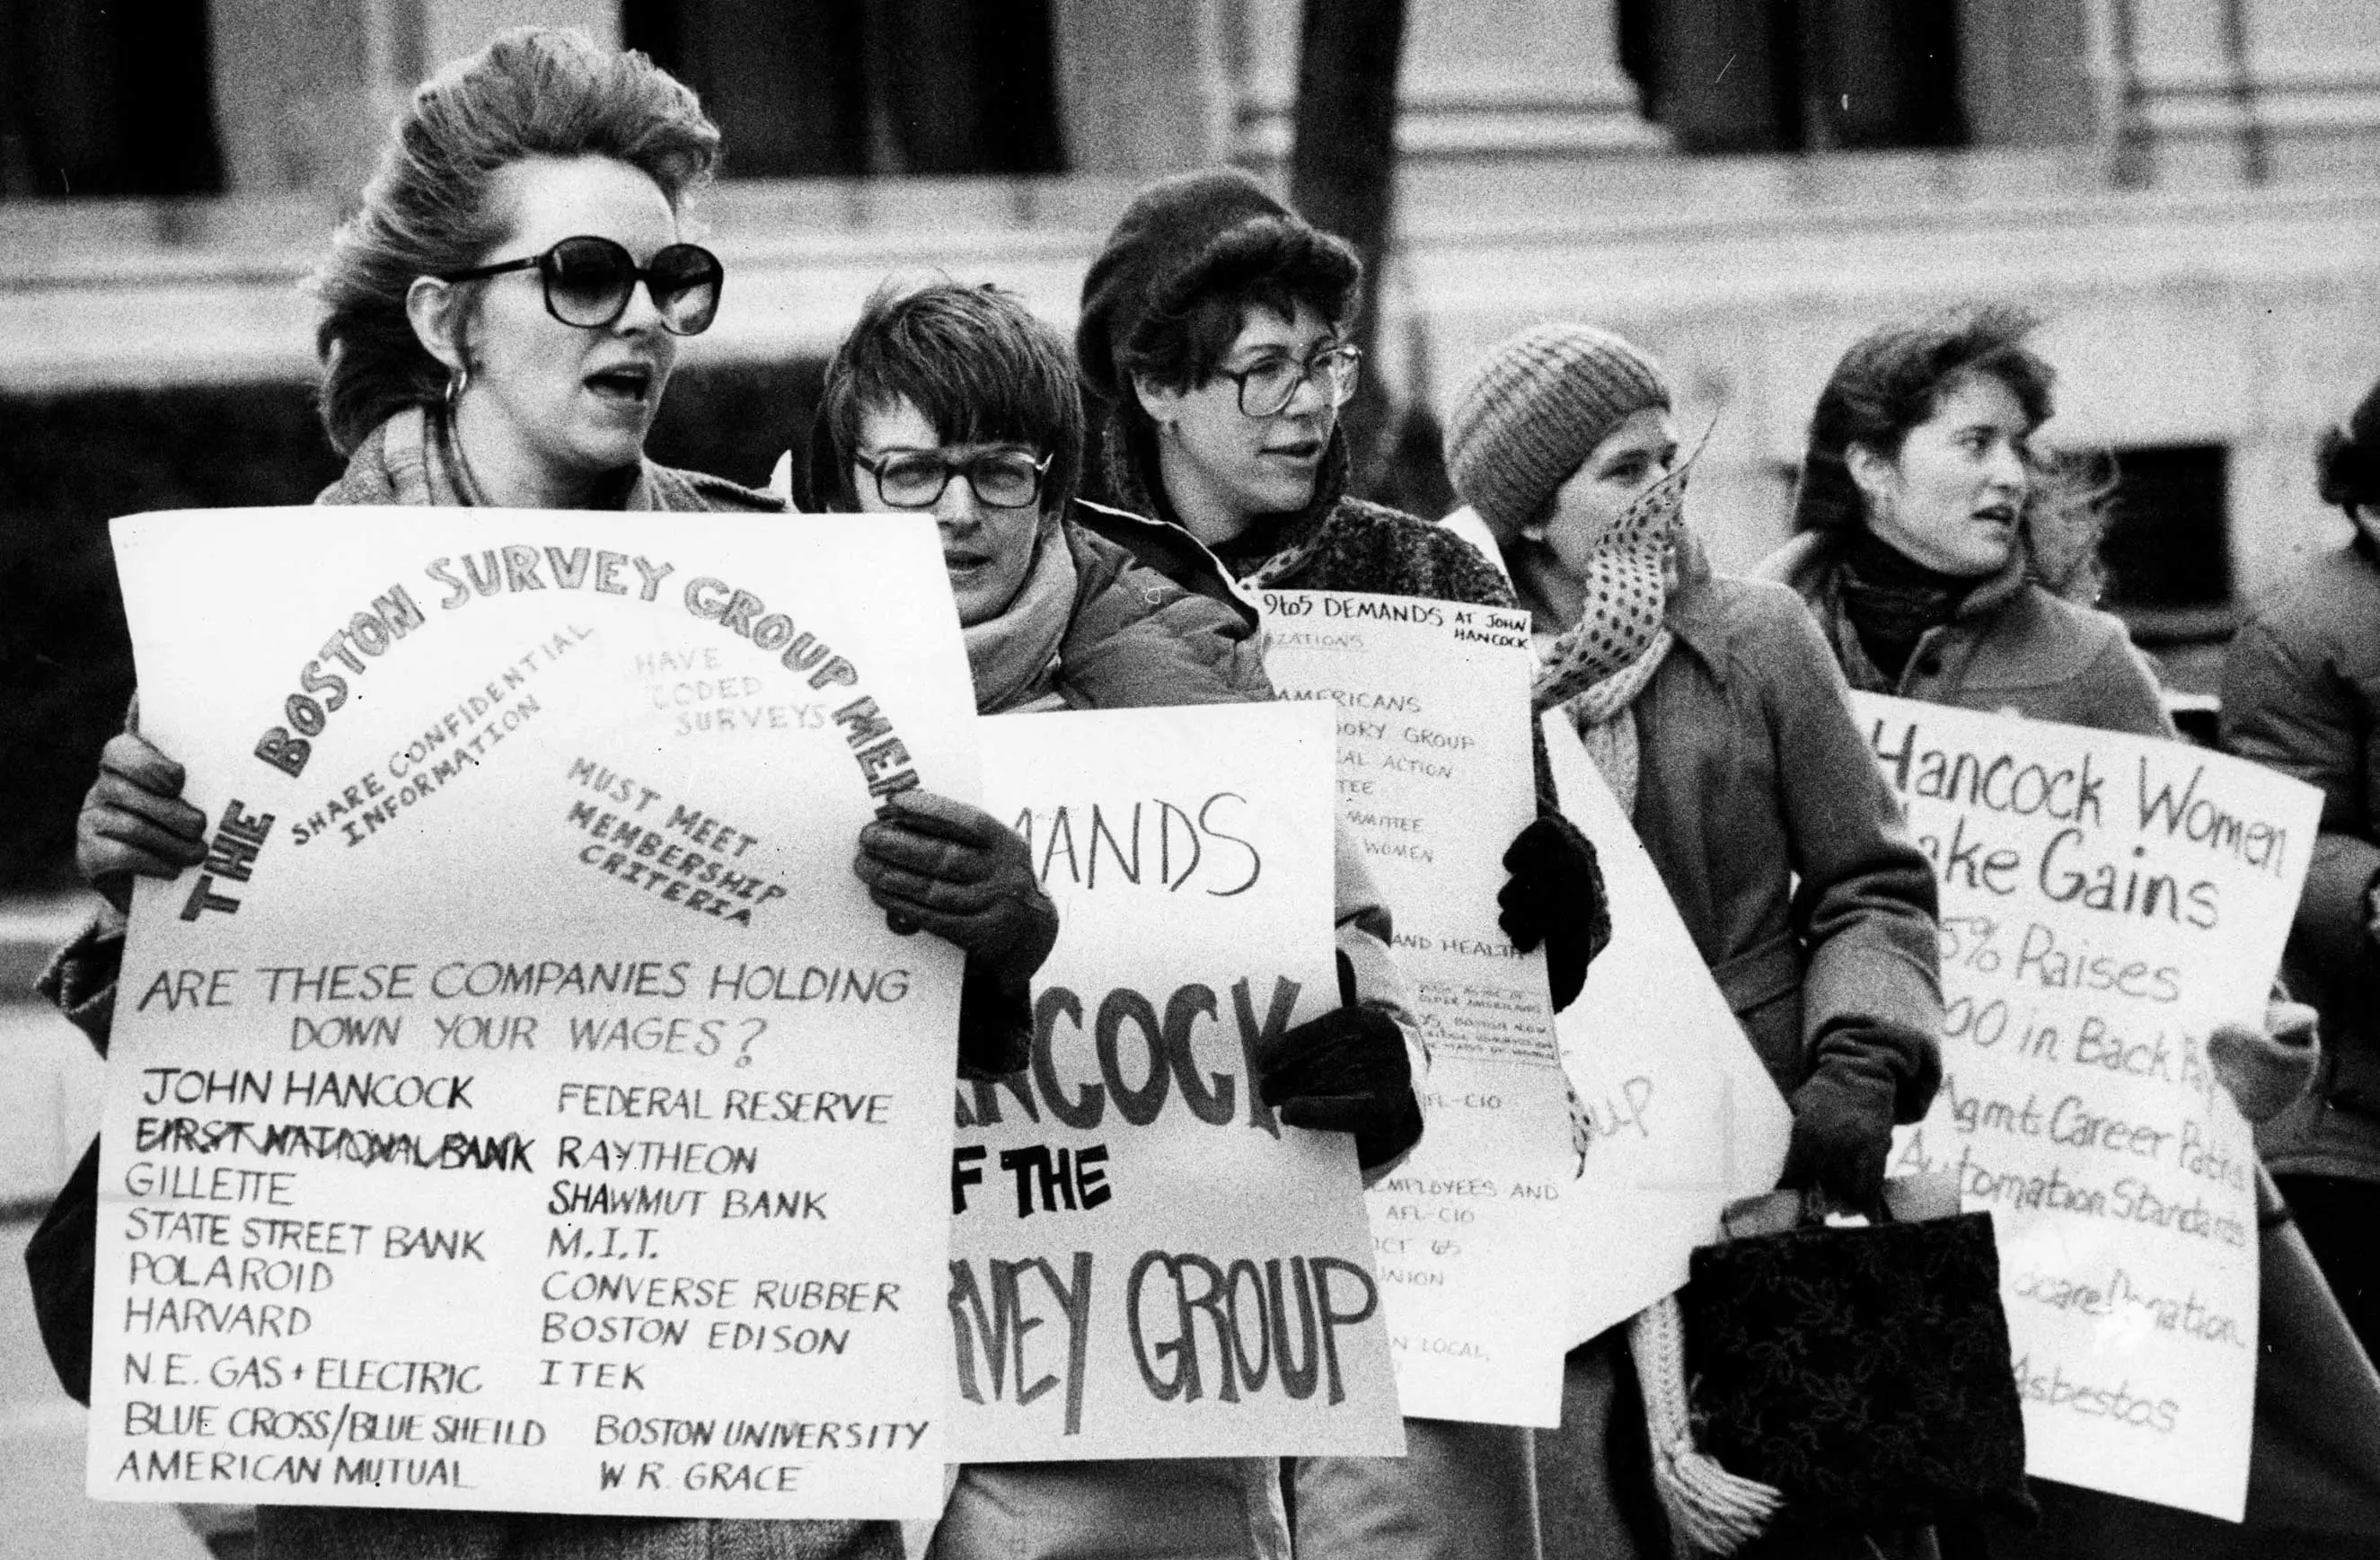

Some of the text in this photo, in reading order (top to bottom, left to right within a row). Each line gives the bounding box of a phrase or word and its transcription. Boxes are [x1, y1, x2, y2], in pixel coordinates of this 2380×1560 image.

[1263, 593, 1528, 632] 9to5 DEMANDS AT JOHN
[1453, 628, 1529, 649] HANCOCK
[634, 647, 722, 675] HAVE
[181, 798, 276, 922] THE
[253, 583, 427, 779] BOSTON
[425, 543, 675, 611] SURVEY
[683, 576, 859, 692] GROUP
[291, 624, 595, 847] SHARE CONFIDENTIAL
[674, 703, 826, 738] SURVEYS
[1403, 726, 1476, 749] GROUP
[340, 692, 542, 848] INFORMATION
[1383, 754, 1453, 780] ACTION
[566, 755, 759, 858] MUST MEET
[1871, 718, 2287, 879] Hancock Women
[567, 799, 789, 905] MEMBERSHIP
[1362, 838, 1434, 863] WOMEN
[1904, 801, 2219, 931] ake Gains
[578, 843, 753, 929] CRITERIA
[1392, 933, 1432, 949] AND
[2017, 922, 2180, 1004] Raises
[137, 960, 912, 1012] ARE THESE COMPANIES HOLDING
[290, 1013, 768, 1069] DOWN YOUR WAGES?
[952, 974, 1302, 1140] COCK
[2018, 1008, 2058, 1063] in
[2076, 1016, 2172, 1083] Back
[143, 1066, 474, 1110] JOHN HANCOCK
[557, 1082, 894, 1124] FEDERAL RESERVE
[1424, 1090, 1502, 1111] FL-CIO
[2049, 1094, 2174, 1158] Career
[440, 1129, 536, 1173] BANK
[557, 1134, 758, 1176] RAYTHEON
[1895, 1127, 2108, 1217] Atomation
[124, 1160, 297, 1205] GILLETTE
[547, 1178, 828, 1221] SHAWMUT BANK
[1000, 1143, 1113, 1219] THE
[1511, 1181, 1560, 1201] AND
[124, 1206, 487, 1262] STATE STREET BANK
[547, 1226, 660, 1259] M.I.T.
[129, 1250, 335, 1293] POLAROID
[541, 1270, 901, 1314] CONVERSE RUBBER
[123, 1296, 313, 1337] HARVARD
[542, 1310, 851, 1356] BOSTON EDISON
[1125, 1248, 1379, 1406] GROUP
[209, 1354, 283, 1390] GAS
[315, 1355, 484, 1395] ELECTRIC
[539, 1358, 647, 1391] ITEK
[124, 1399, 220, 1437] BLUE
[430, 1414, 548, 1448] SHEILD
[595, 1414, 930, 1451] BOSTON UNIVERSITY
[116, 1448, 480, 1489] AMERICAN MUTUAL
[683, 1461, 805, 1492] GRACE
